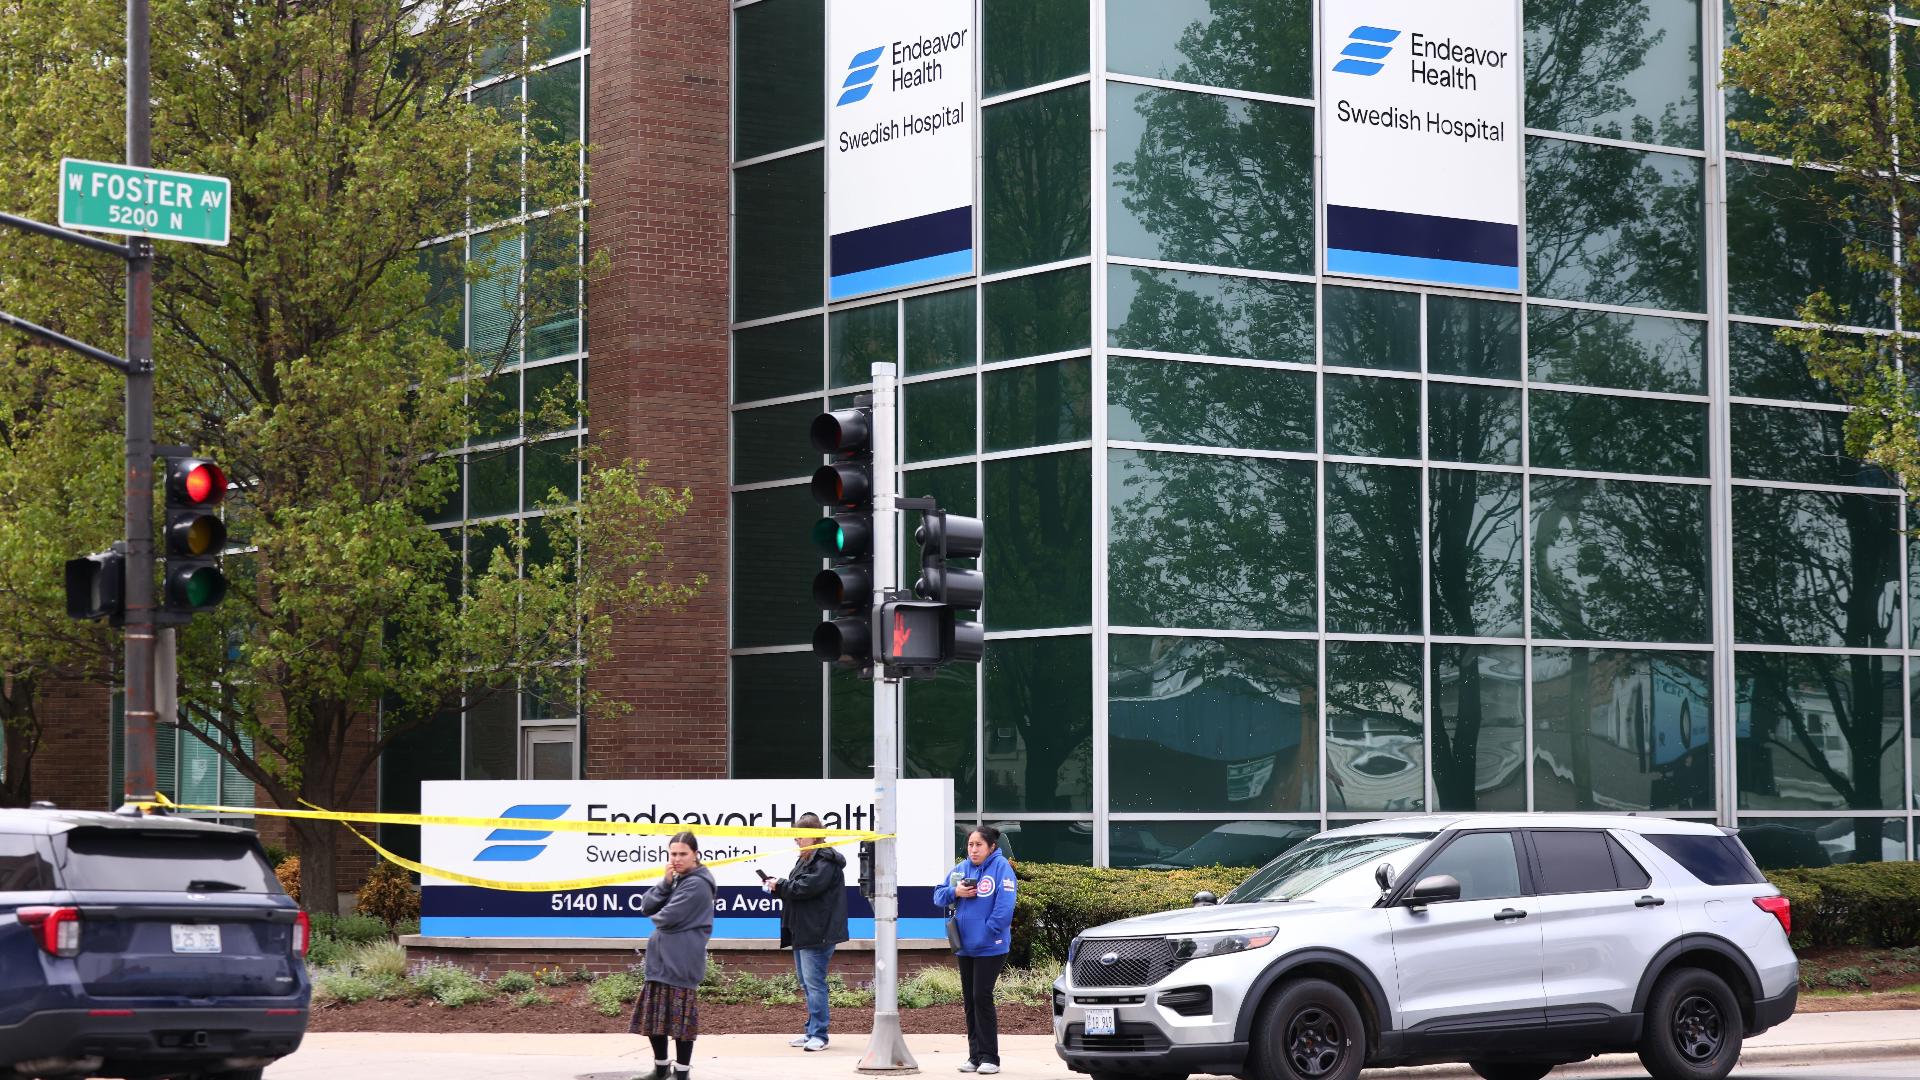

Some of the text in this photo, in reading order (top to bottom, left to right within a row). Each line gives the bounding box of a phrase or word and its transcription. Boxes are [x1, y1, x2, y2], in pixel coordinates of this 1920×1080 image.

[892, 28, 968, 66] Endeavor
[1411, 32, 1508, 68] Endeavor
[892, 59, 942, 92] Health
[1411, 60, 1477, 90] Health
[839, 101, 964, 152] Swedish Hospital
[1337, 100, 1504, 142] Swedish Hospital
[68, 172, 223, 208] W FOSTER AV
[108, 205, 183, 230] 5200 N
[771, 803, 875, 832] Halt
[586, 845, 669, 863] Swedish
[551, 893, 598, 911] 5140
[603, 893, 624, 911] N.
[732, 893, 784, 911] Aven
